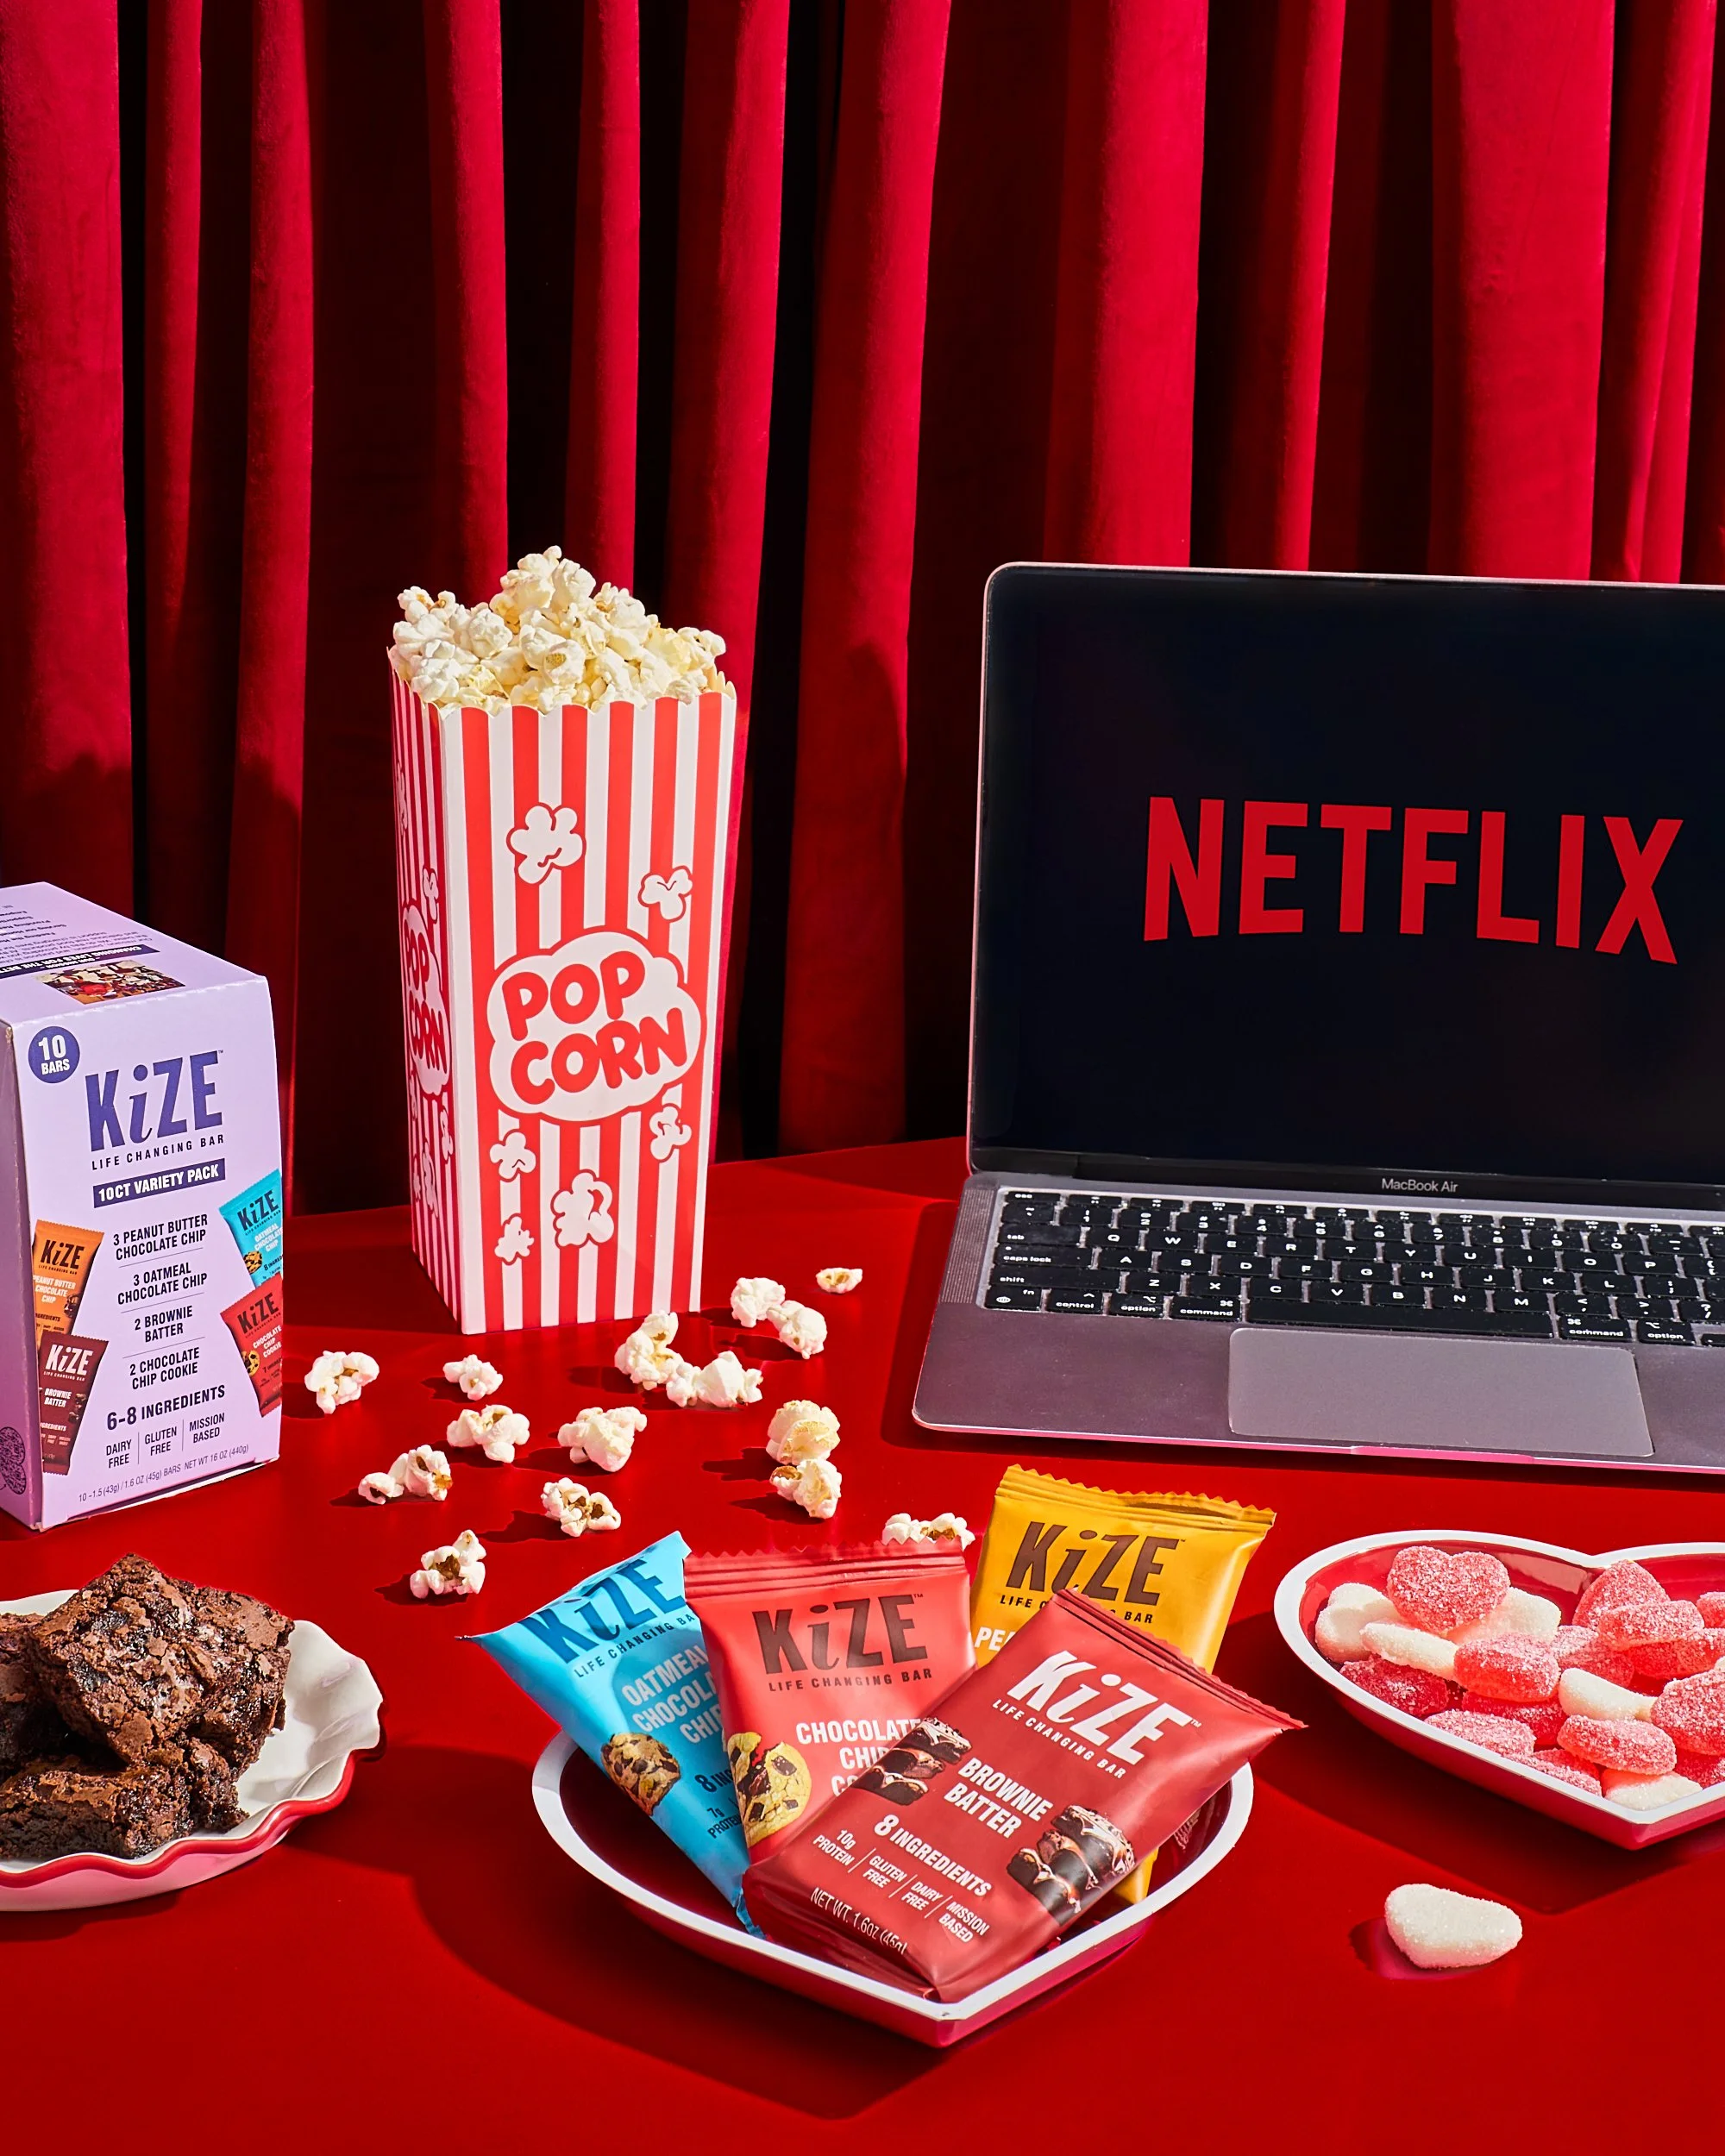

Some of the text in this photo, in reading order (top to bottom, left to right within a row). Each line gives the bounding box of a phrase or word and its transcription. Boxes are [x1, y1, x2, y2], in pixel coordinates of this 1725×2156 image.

[1144, 796, 1684, 964] NETFLIX
[404, 918, 430, 1001] POP
[502, 950, 645, 1041] POP
[409, 990, 447, 1074] CORN
[38, 1034, 66, 1061] 10
[511, 1007, 687, 1105] CORN
[41, 1058, 70, 1075] BARS
[85, 1050, 223, 1152] KiZE
[91, 1134, 224, 1170] LIFE CHANGING BAR
[98, 1163, 219, 1202] 10CT VARIETY PACK
[1382, 1178, 1458, 1193] MacBook Air
[113, 1213, 208, 1246] 3 PEANUT BUTTER
[1107, 1234, 1120, 1243] Q
[1164, 1237, 1181, 1245] W
[116, 1229, 206, 1261] CHOCOLATE CHIP
[1120, 1256, 1132, 1264] A
[1360, 1268, 1373, 1276] G
[54, 1278, 76, 1290] BUTTER
[134, 1262, 191, 1287] 3 OATMEAL
[1604, 1280, 1615, 1288] L
[35, 1285, 68, 1297] CHOCOLATE
[41, 1295, 56, 1304] CHIP
[117, 1273, 208, 1305] CHOCOLATE CHIP
[1056, 1300, 1095, 1309] control
[135, 1306, 193, 1331] 2 BROWNIE
[145, 1323, 184, 1343] BATTER
[253, 1325, 282, 1349] CHOCOLATE
[263, 1337, 276, 1350] CHIP
[1647, 1332, 1684, 1340] option
[129, 1347, 200, 1376] 2 CHOCOLATE
[263, 1341, 282, 1358] COOKIE
[132, 1362, 198, 1390] CHIP COOKIE
[44, 1388, 72, 1400] BROWNIE
[44, 1397, 66, 1408] BATTER
[107, 1385, 225, 1430] 6-8 INGREDIENTS
[189, 1413, 225, 1432] MISSION
[145, 1426, 177, 1445] GLUTEN
[193, 1426, 220, 1444] BASED
[105, 1439, 132, 1457] DAIRY
[150, 1441, 171, 1457] FREE
[109, 1453, 129, 1469] FREE
[78, 1493, 87, 1502] 10
[135, 1476, 144, 1485] OZ
[146, 1470, 162, 1483] (45g)
[164, 1465, 181, 1476] BARS
[184, 1459, 197, 1470] NET
[198, 1456, 209, 1466] WT
[210, 1453, 217, 1463] 16
[220, 1450, 228, 1460] OZ
[229, 1445, 248, 1458] (440g)
[1006, 1520, 1180, 1606] KiZE
[1000, 1595, 1032, 1608] LIFE
[1124, 1611, 1153, 1624] BAR
[574, 1614, 695, 1678] LIFE CHANGING BA
[752, 1595, 928, 1675] KiZE
[768, 1668, 932, 1692] LIFE CHANGING BAR
[1007, 1650, 1194, 1765] KiZE
[993, 1699, 1126, 1778] LIFE CHANGING BAR
[694, 1774, 717, 1792] 8
[958, 1757, 1054, 1822] BROWNIE
[707, 1807, 724, 1818] 7g
[944, 1782, 1022, 1839] BATTER
[812, 1835, 855, 1865] PROTEIN
[837, 1829, 856, 1850] 10g
[874, 1814, 991, 1896] 8 INGREDIENTS
[862, 1868, 891, 1889] FREE
[869, 1855, 907, 1883] GLUTEN
[901, 1891, 929, 1911] FREE
[911, 1881, 944, 1902] DAIRY
[811, 1887, 835, 1911] NET
[833, 1899, 852, 1923] WT.
[938, 1914, 974, 1943] BASED
[946, 1902, 990, 1936] MISSION
